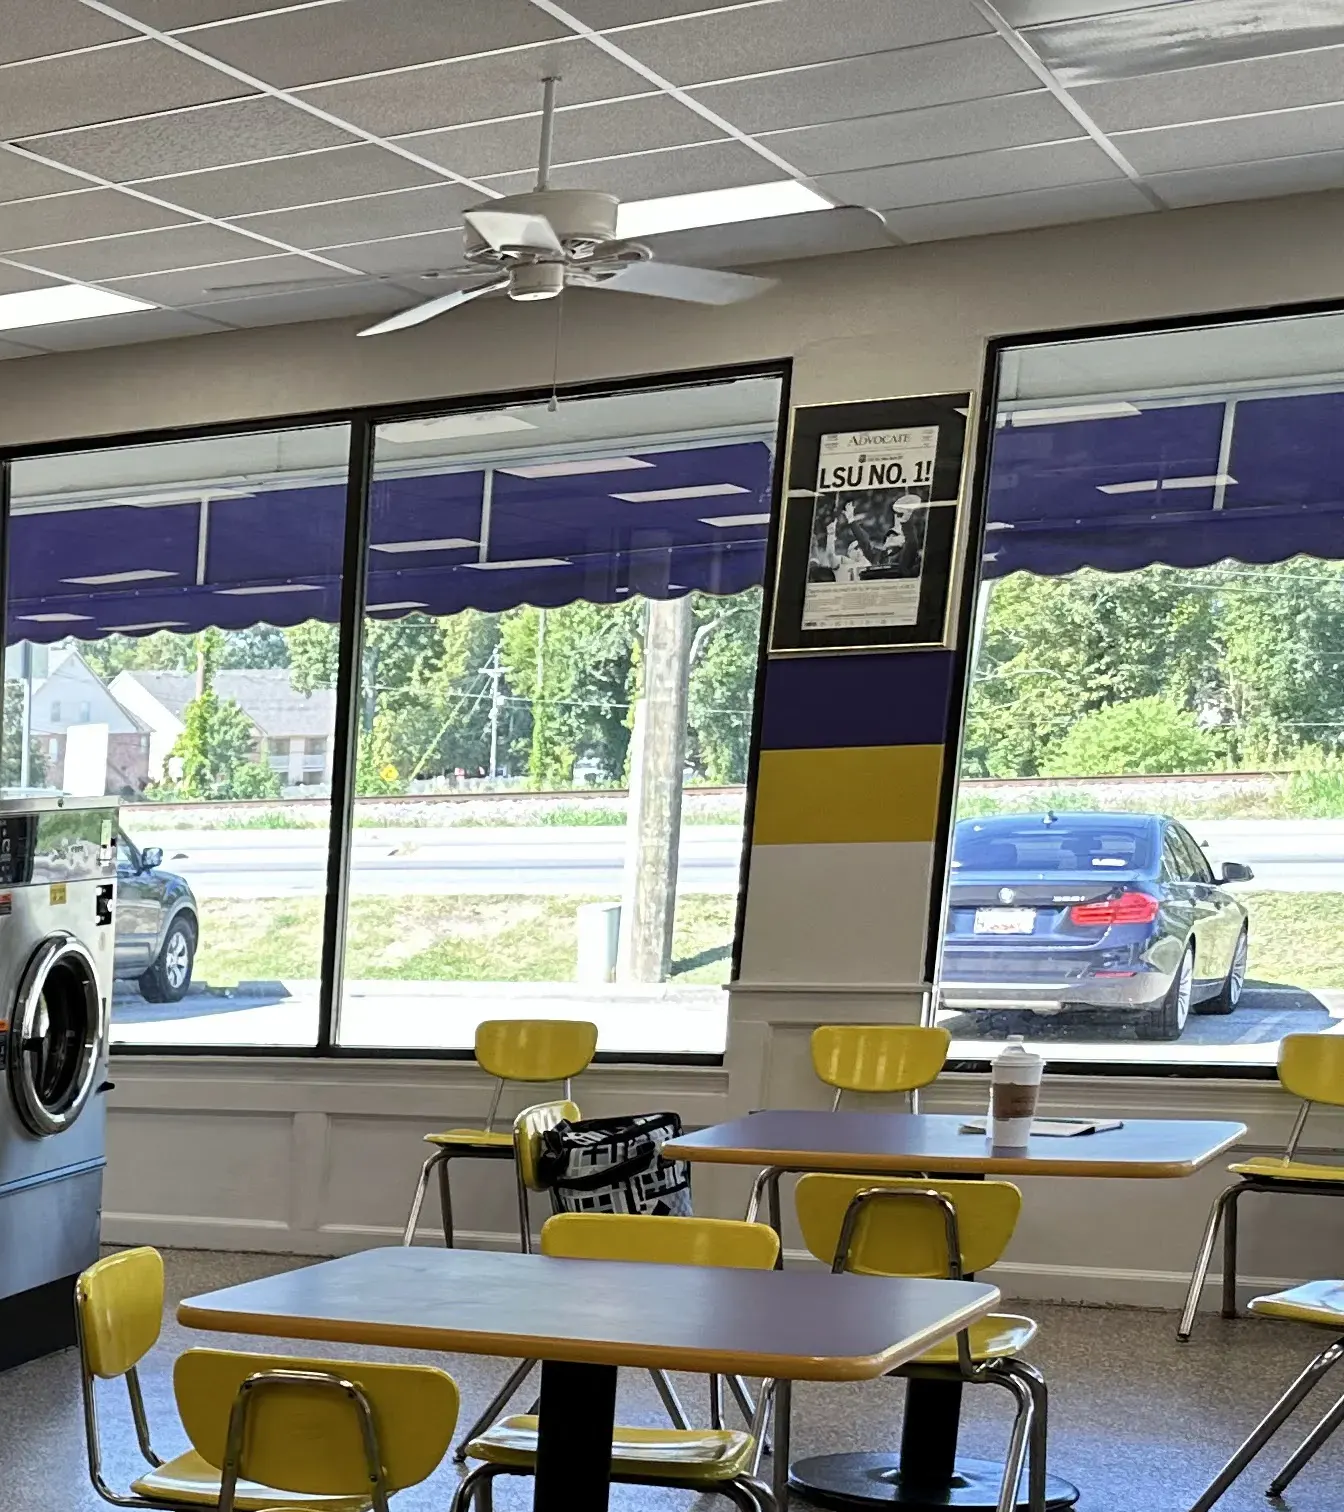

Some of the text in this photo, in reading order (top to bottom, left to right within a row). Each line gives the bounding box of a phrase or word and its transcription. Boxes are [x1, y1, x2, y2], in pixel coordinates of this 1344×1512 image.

[849, 433, 910, 446] ADVOCATE
[819, 461, 932, 489] LSU NO. 1!
